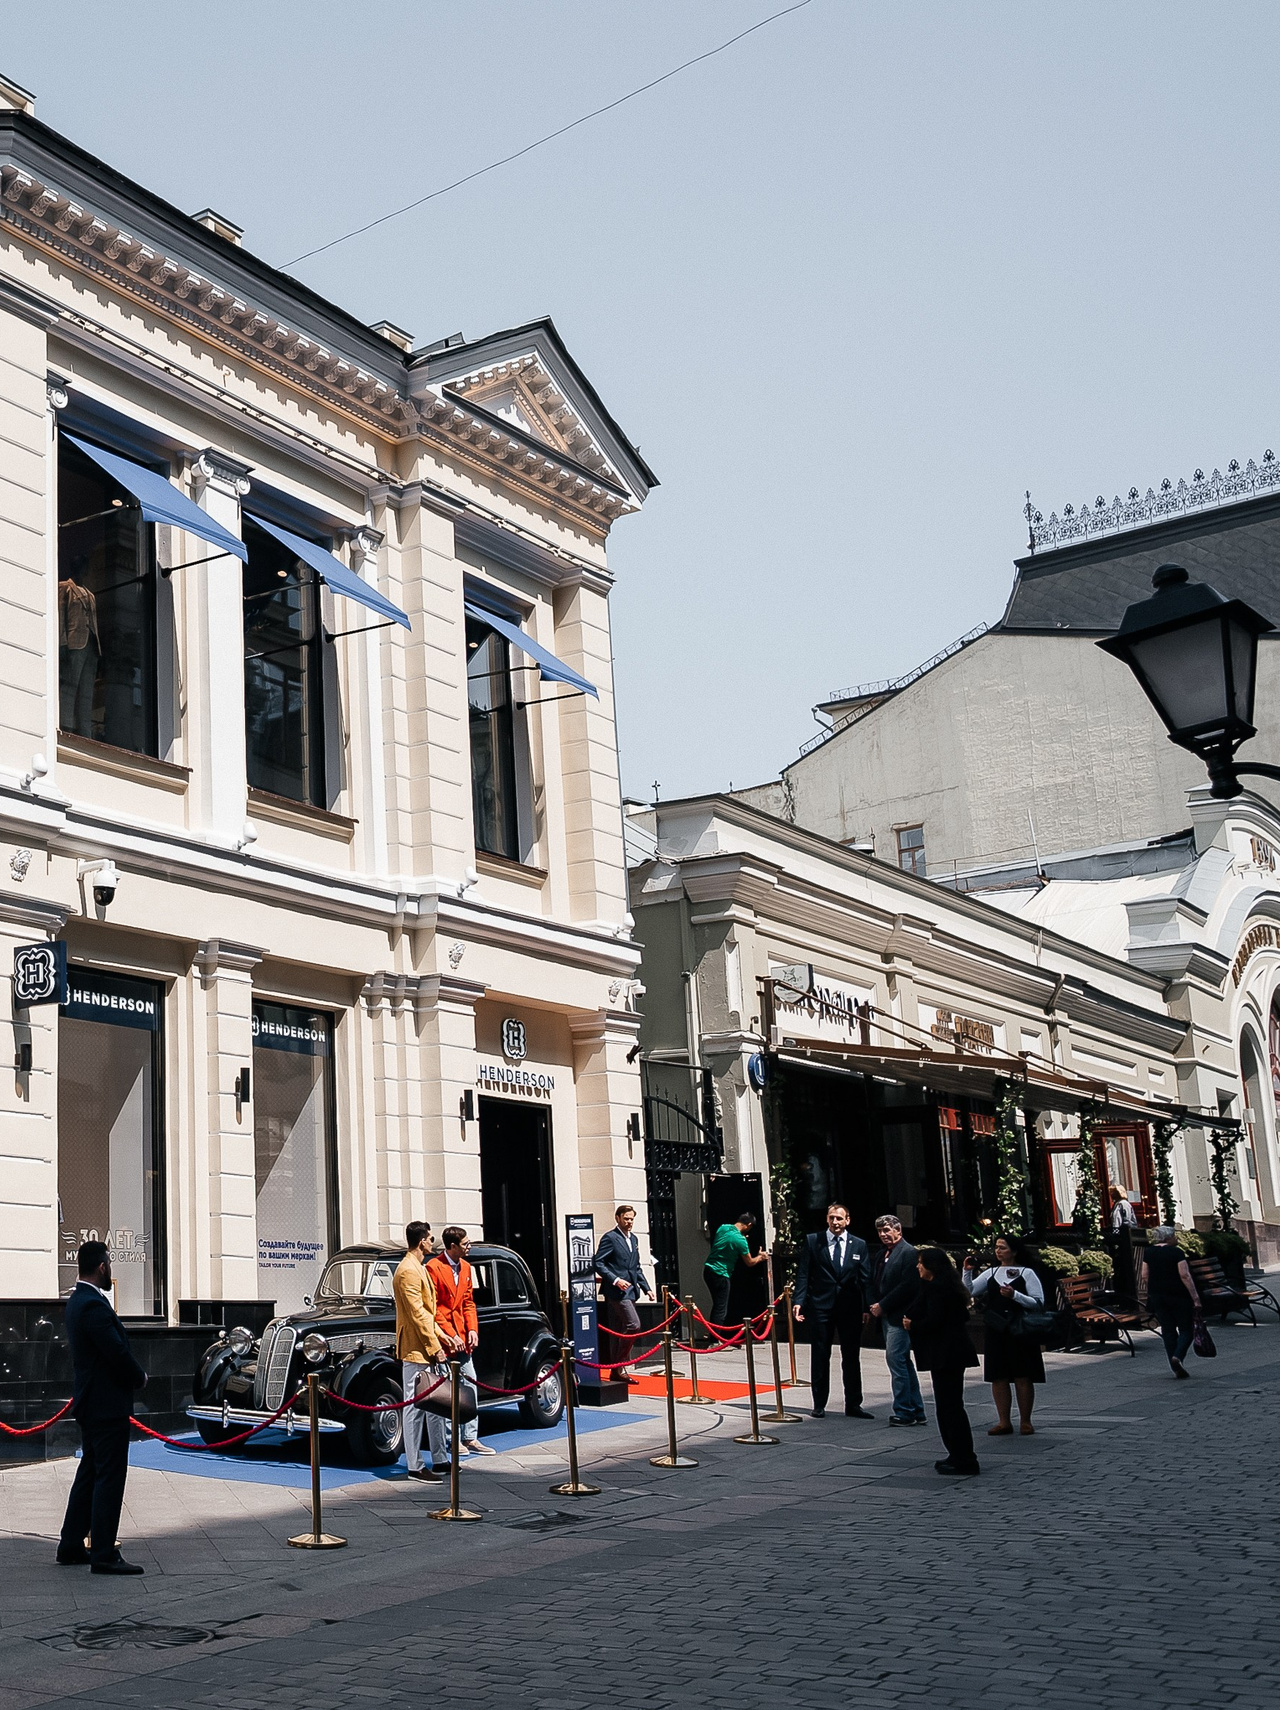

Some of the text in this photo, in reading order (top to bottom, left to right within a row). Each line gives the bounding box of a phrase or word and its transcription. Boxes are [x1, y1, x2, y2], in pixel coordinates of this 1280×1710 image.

[73, 989, 155, 1015] HENDERSON
[261, 1021, 326, 1042] HENDERSON
[479, 1064, 555, 1090] HENDERSON
[104, 1230, 134, 1249] ЛЕТ
[258, 1239, 324, 1251] Создавайте будущее
[118, 1251, 147, 1263] СТИЛЯ
[258, 1251, 267, 1259] по
[268, 1252, 290, 1260] вашим
